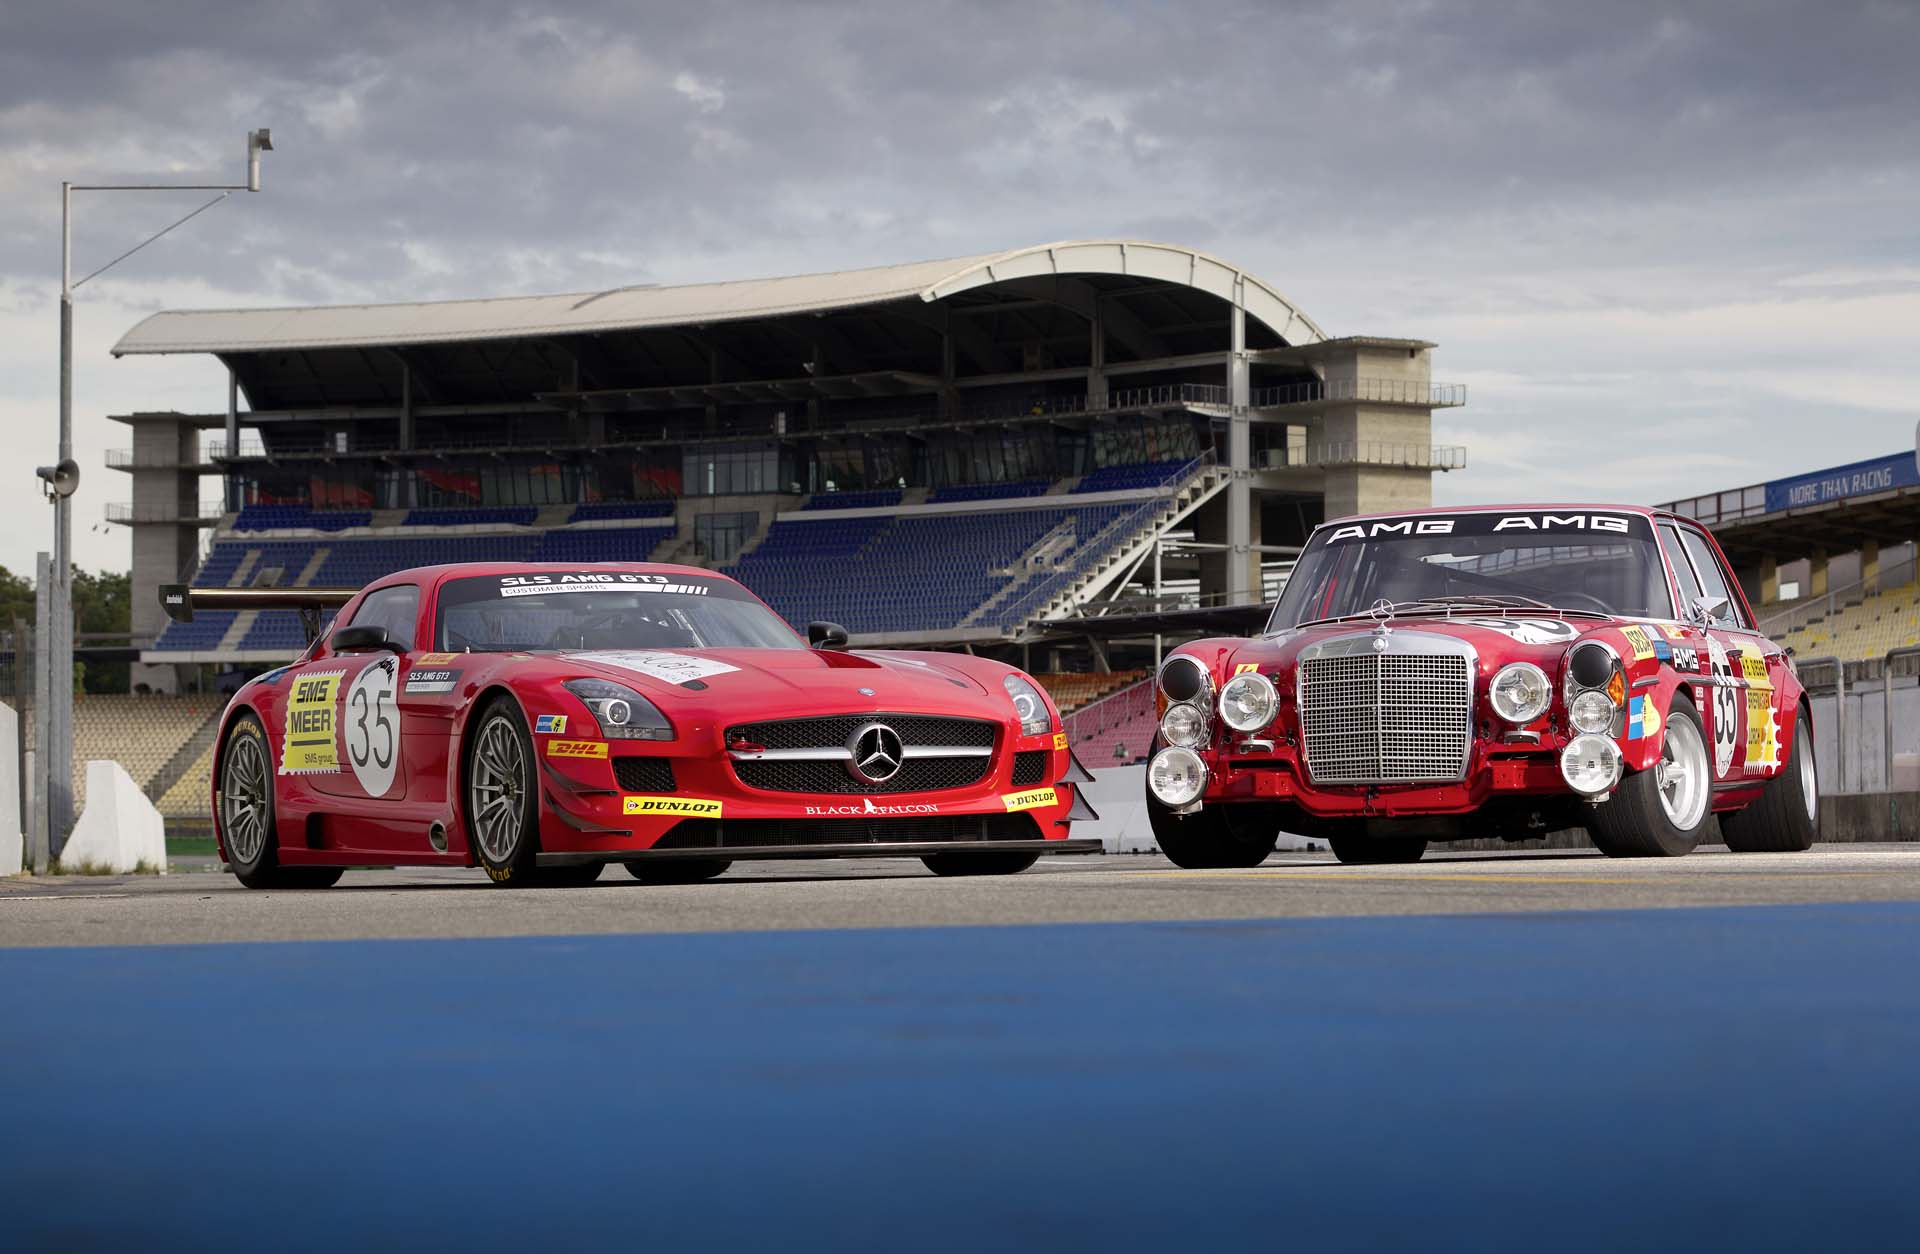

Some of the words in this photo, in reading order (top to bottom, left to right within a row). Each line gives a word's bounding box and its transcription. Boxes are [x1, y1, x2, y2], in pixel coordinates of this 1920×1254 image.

[1789, 483, 1818, 504] MORE
[1821, 477, 1848, 499] THAN
[1852, 467, 1892, 492] RACING
[1326, 520, 1455, 545] AMG
[1492, 515, 1629, 533] AMG
[501, 576, 552, 586] SLS
[560, 574, 613, 583] AMG
[620, 575, 669, 583] GT3
[505, 585, 564, 595] CUSTOMER
[1672, 647, 1699, 670] AMG
[409, 671, 421, 680] SLS
[421, 671, 437, 680] AMG
[436, 671, 450, 680] GT3
[296, 680, 330, 703] SMS
[1711, 661, 1736, 745] 35
[291, 709, 331, 733] MEER
[351, 687, 392, 769] 35
[555, 743, 598, 755] DHL
[641, 801, 719, 813] DUNLOP
[1016, 792, 1055, 805] DUNLOP
[805, 806, 862, 815] BLACK
[877, 804, 939, 815] FALCON
